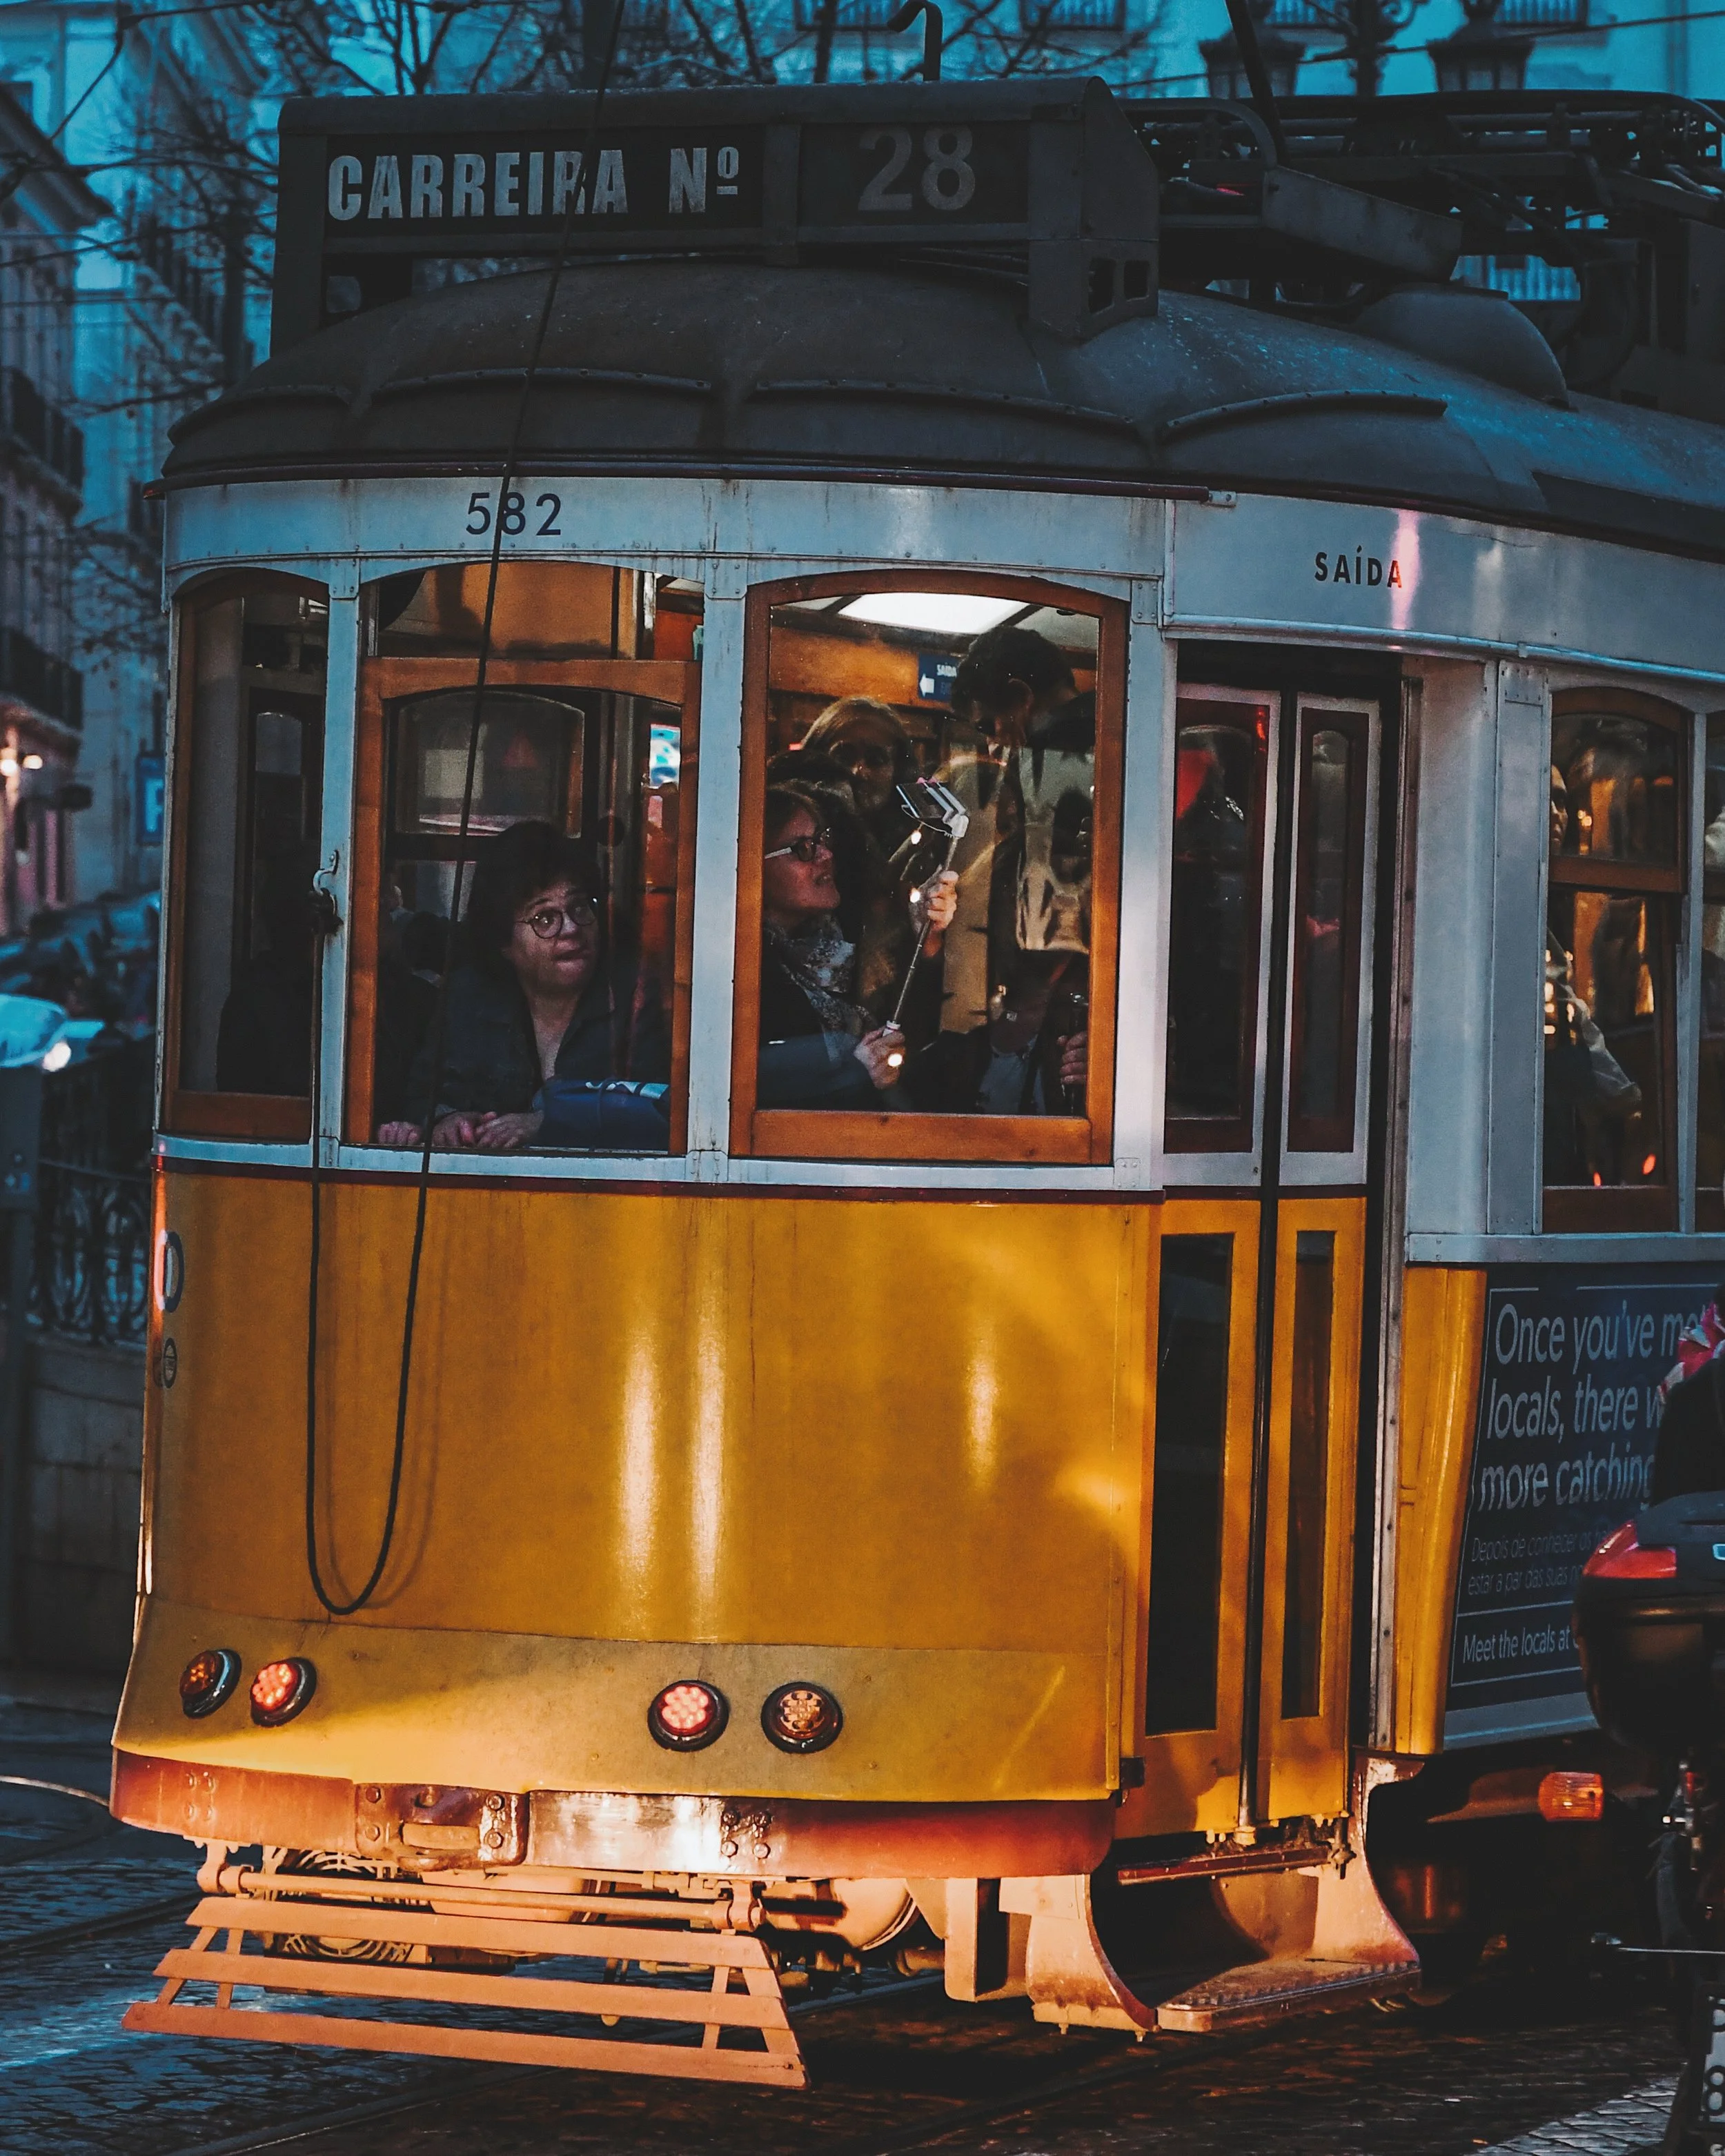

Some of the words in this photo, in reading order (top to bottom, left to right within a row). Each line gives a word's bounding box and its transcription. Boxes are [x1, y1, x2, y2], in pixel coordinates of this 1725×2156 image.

[327, 149, 630, 221] CARREIRA
[669, 146, 740, 214] Nº
[857, 123, 976, 212] 28
[466, 492, 562, 535] 582
[1314, 544, 1402, 589] SAÍDA
[1495, 1303, 1566, 1365] Once
[1573, 1299, 1655, 1375] you've
[1486, 1375, 1565, 1444] locals,
[1574, 1373, 1639, 1434] there
[1478, 1462, 1549, 1512] more
[1463, 1633, 1496, 1663] Meet
[1499, 1629, 1519, 1659] the
[1521, 1623, 1557, 1656] locals
[1558, 1625, 1571, 1650] at
